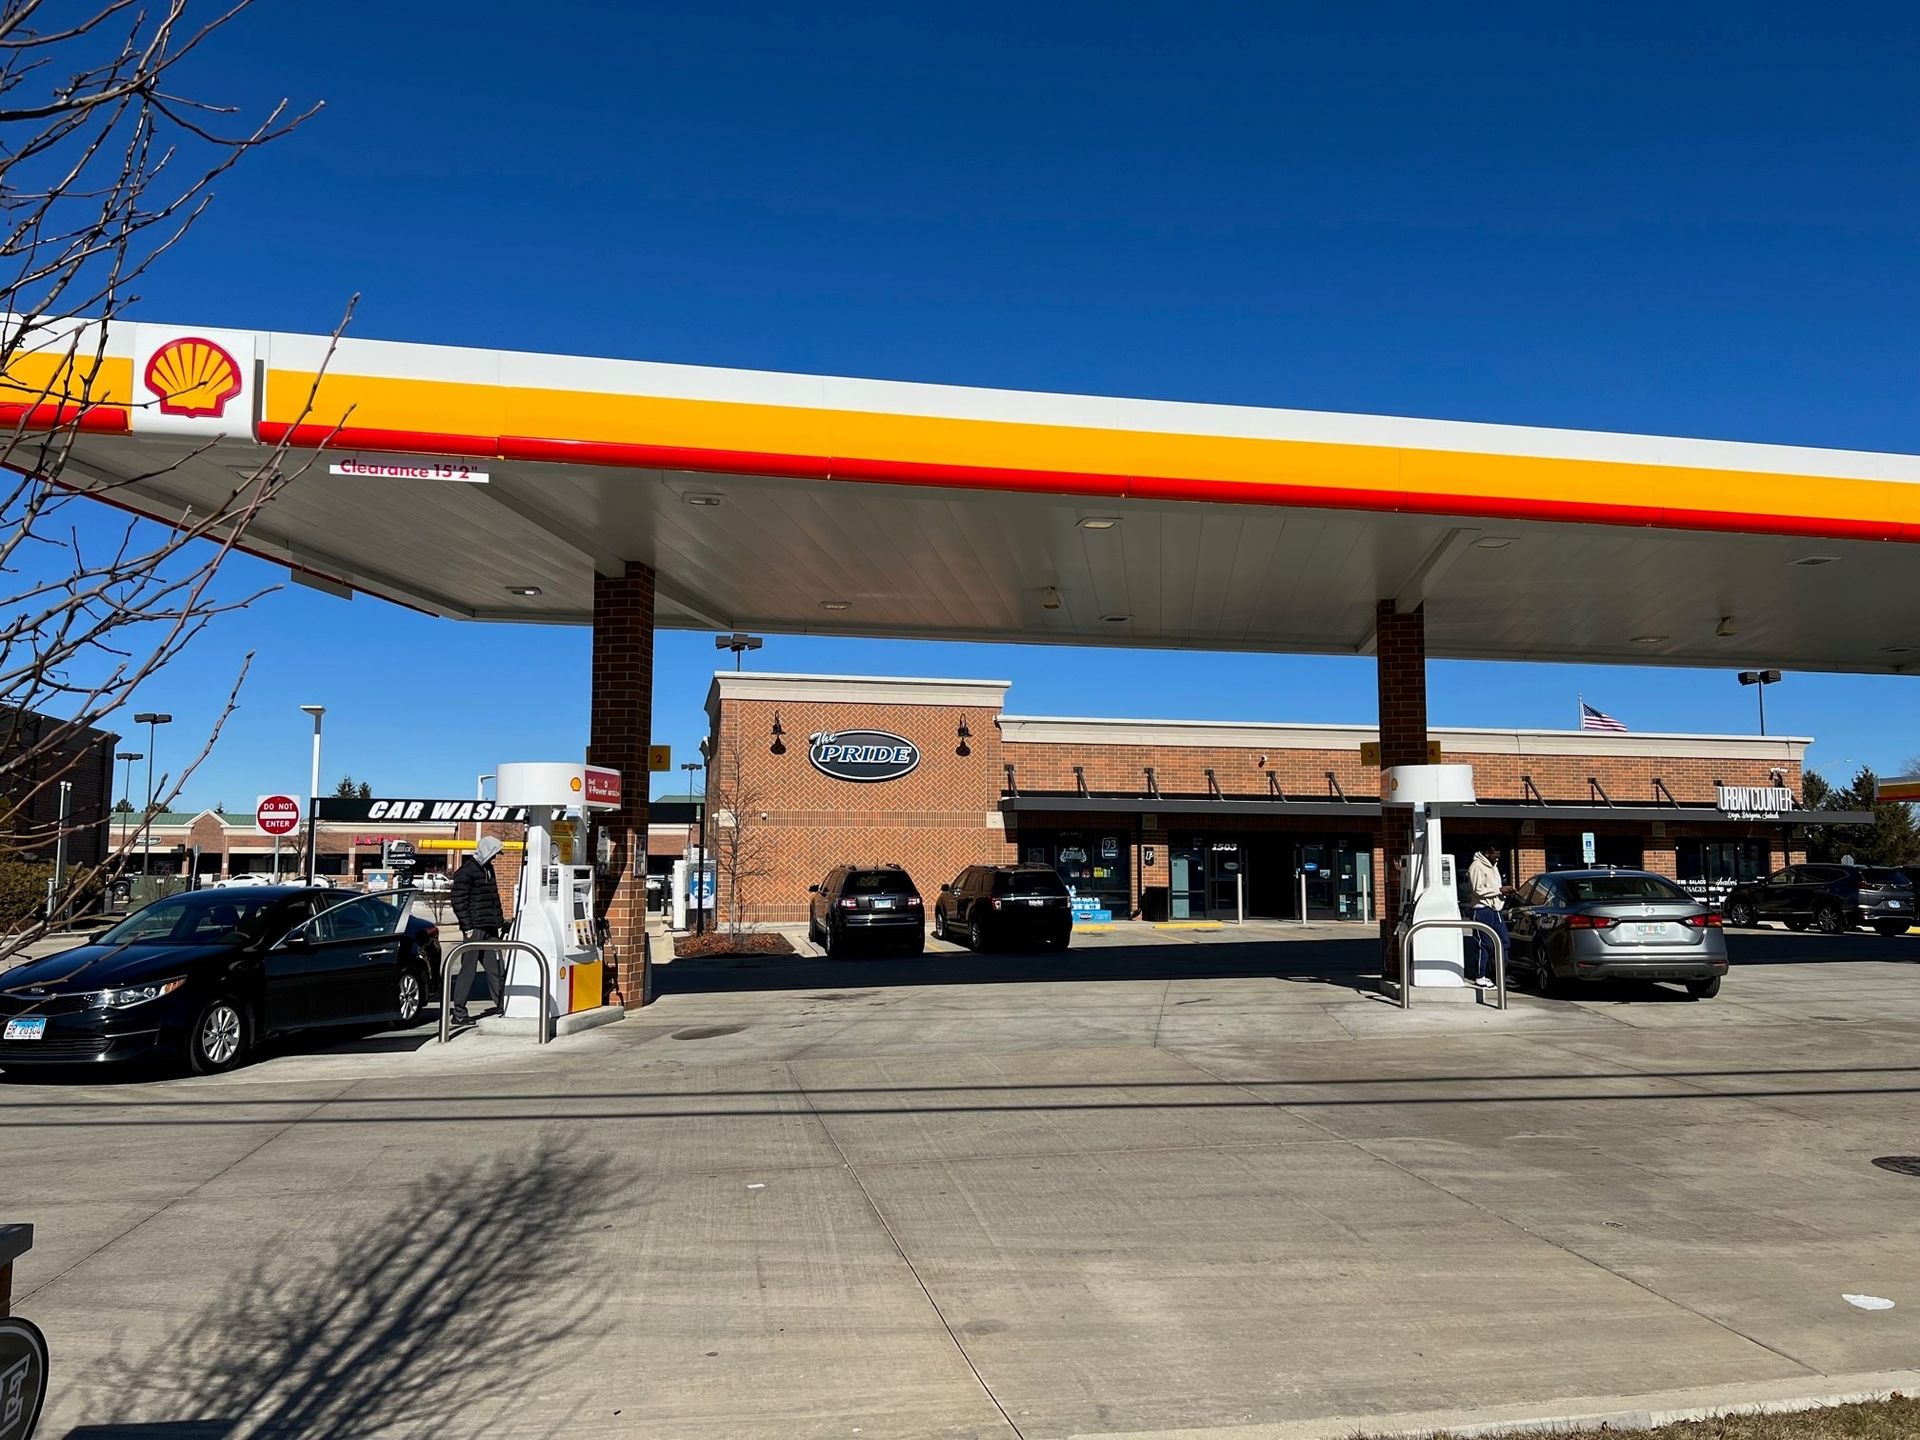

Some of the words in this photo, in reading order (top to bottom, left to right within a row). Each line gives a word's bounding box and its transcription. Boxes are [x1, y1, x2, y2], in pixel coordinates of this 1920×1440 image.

[340, 459, 429, 478] Clearance
[434, 463, 478, 479] 15'2"
[809, 731, 838, 747] The
[818, 745, 912, 764] PRIDE
[263, 803, 275, 811] DO
[278, 803, 294, 811] NOT
[1718, 786, 1750, 811] URBAN
[1751, 787, 1794, 812] COUNTER
[368, 800, 425, 820] CAR
[430, 801, 509, 821] WASH
[265, 820, 290, 828] ENTER
[1104, 839, 1118, 850] 93
[1211, 843, 1238, 851] 1503
